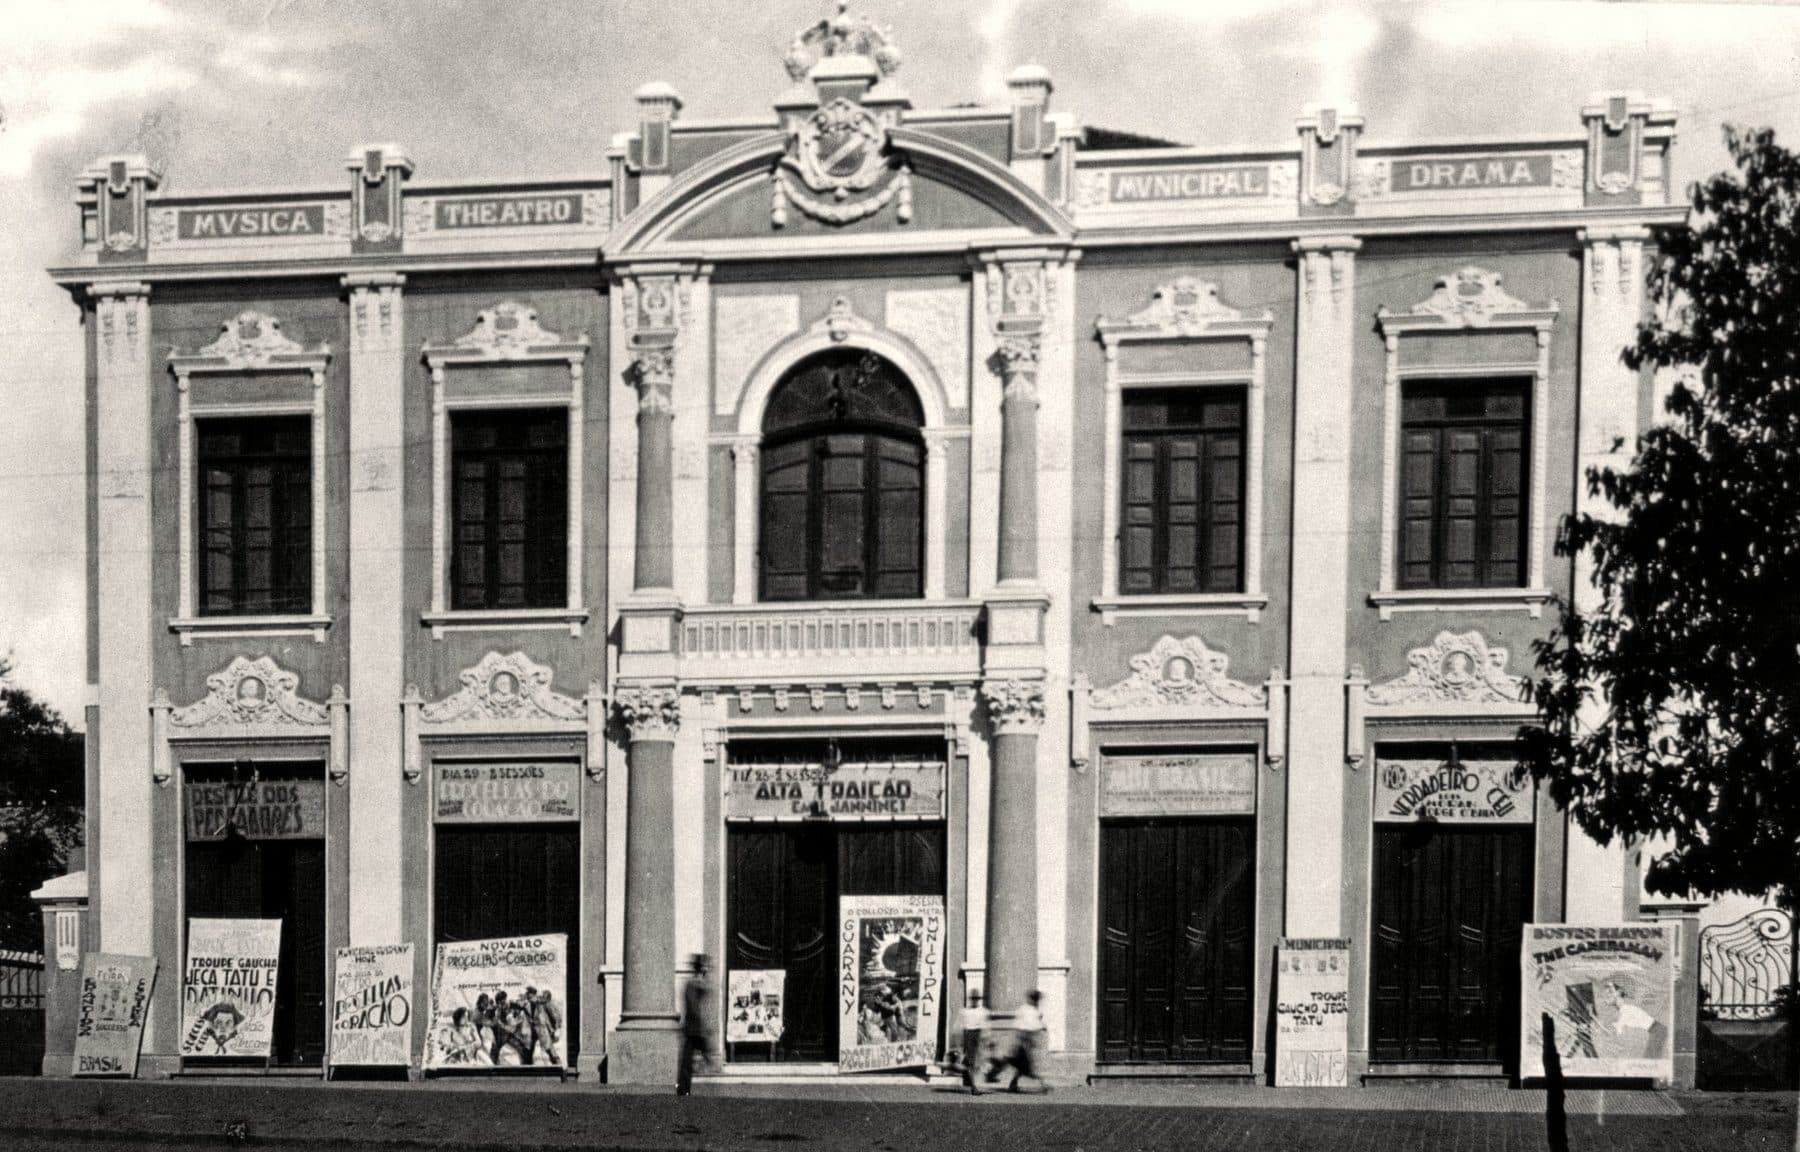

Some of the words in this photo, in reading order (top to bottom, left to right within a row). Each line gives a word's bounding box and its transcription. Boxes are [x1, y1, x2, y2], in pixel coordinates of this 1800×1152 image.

[1116, 169, 1265, 200] MVNICIPAL
[1409, 159, 1533, 188] DRAMA
[192, 209, 313, 236] MVSICA
[445, 198, 573, 226] THEATRO
[755, 780, 803, 801] ALTA
[1389, 771, 1480, 817] VERDADEIRO
[191, 957, 233, 968] TROUPE
[841, 919, 856, 1016] GUARANY
[920, 916, 940, 1017] MUNICIPAL
[1532, 948, 1566, 964] THE
[185, 968, 217, 986] JECA
[222, 968, 260, 986] TATU
[266, 969, 275, 986] E
[1293, 1015, 1324, 1025] TATU
[1322, 1003, 1348, 1014] JECA
[79, 1056, 122, 1072] BRASIL
